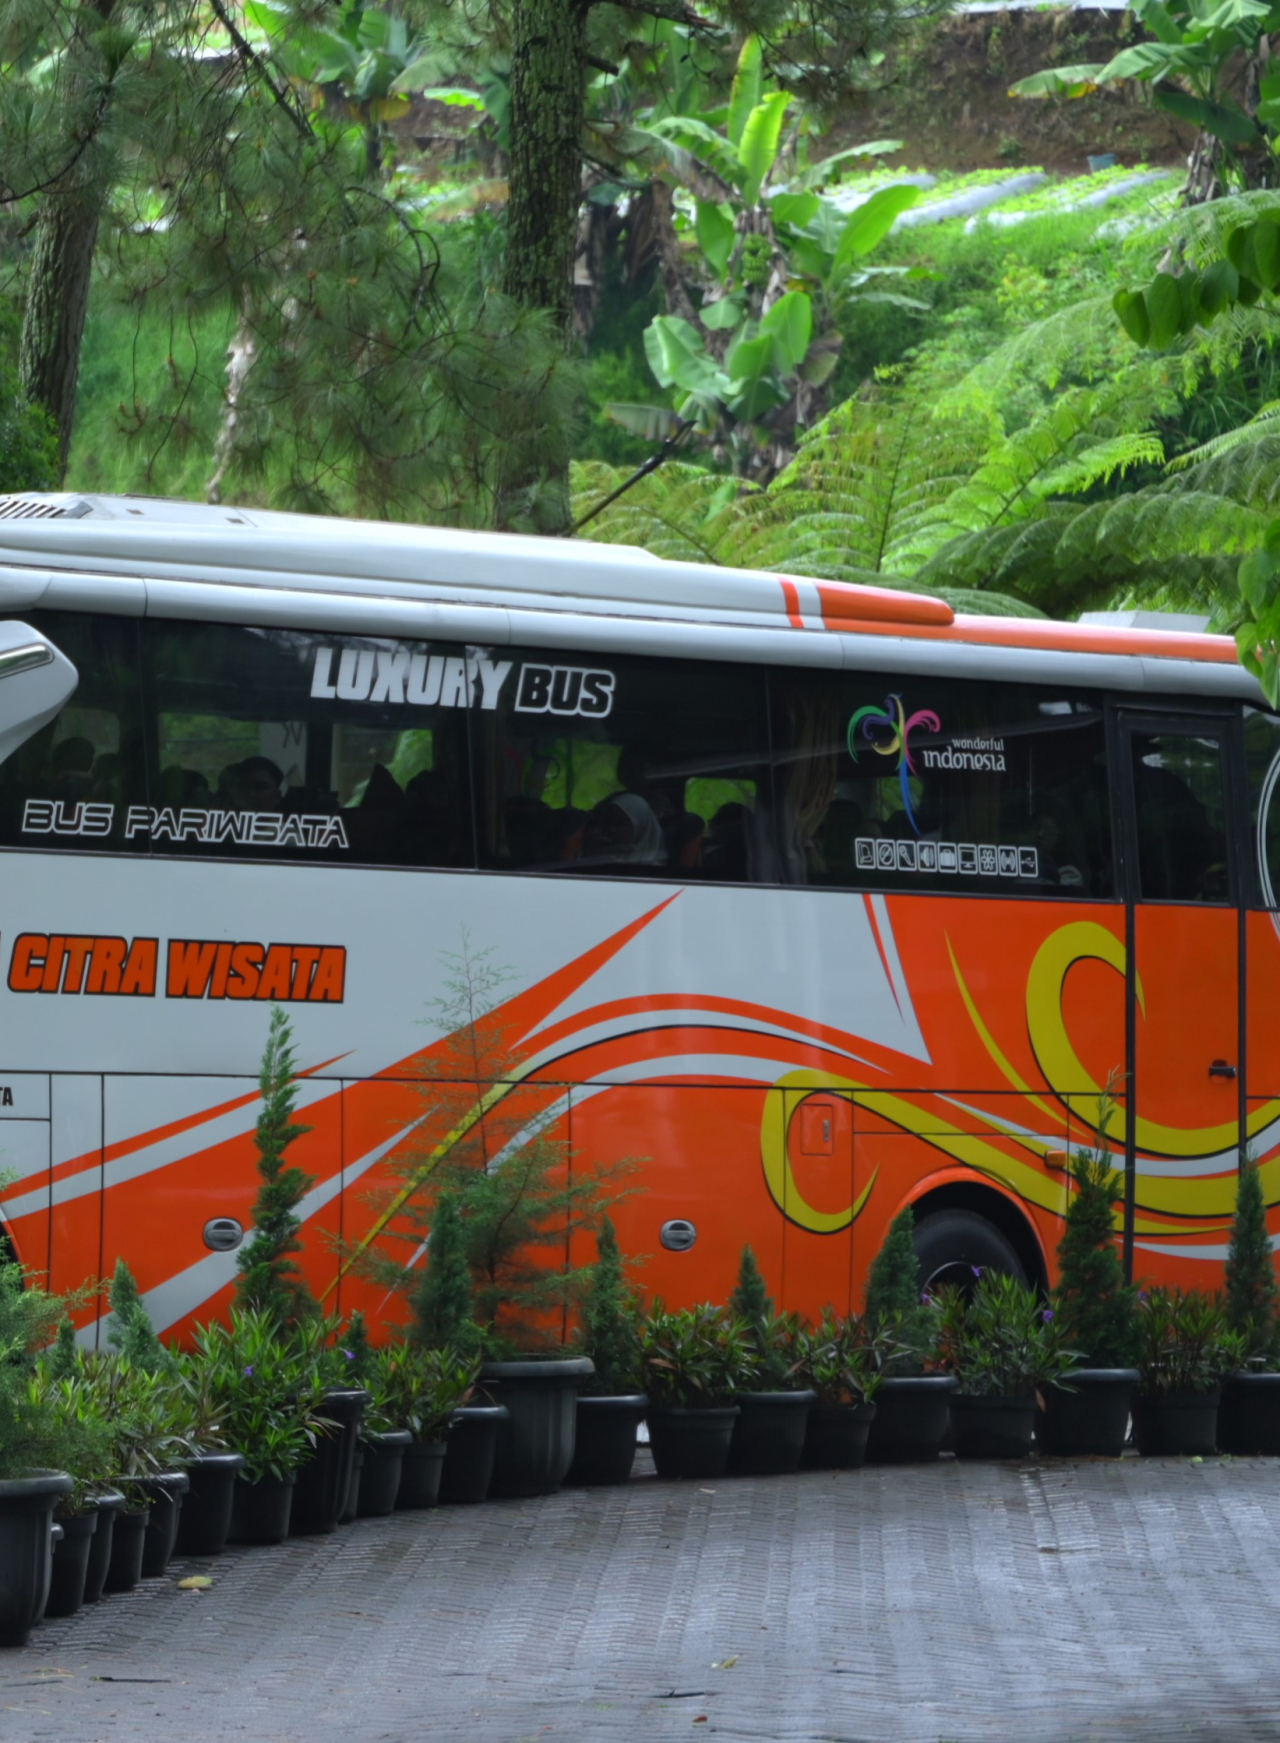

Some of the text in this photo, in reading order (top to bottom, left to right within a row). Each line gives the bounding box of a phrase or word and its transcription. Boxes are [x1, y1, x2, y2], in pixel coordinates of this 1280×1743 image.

[310, 647, 616, 718] LUXURY BUS
[922, 746, 1007, 771] indonesia
[951, 737, 1005, 751] wonderful
[21, 799, 349, 848] BUS PARIWISATA
[7, 932, 160, 998] CITRA
[165, 938, 347, 1004] WISATA
